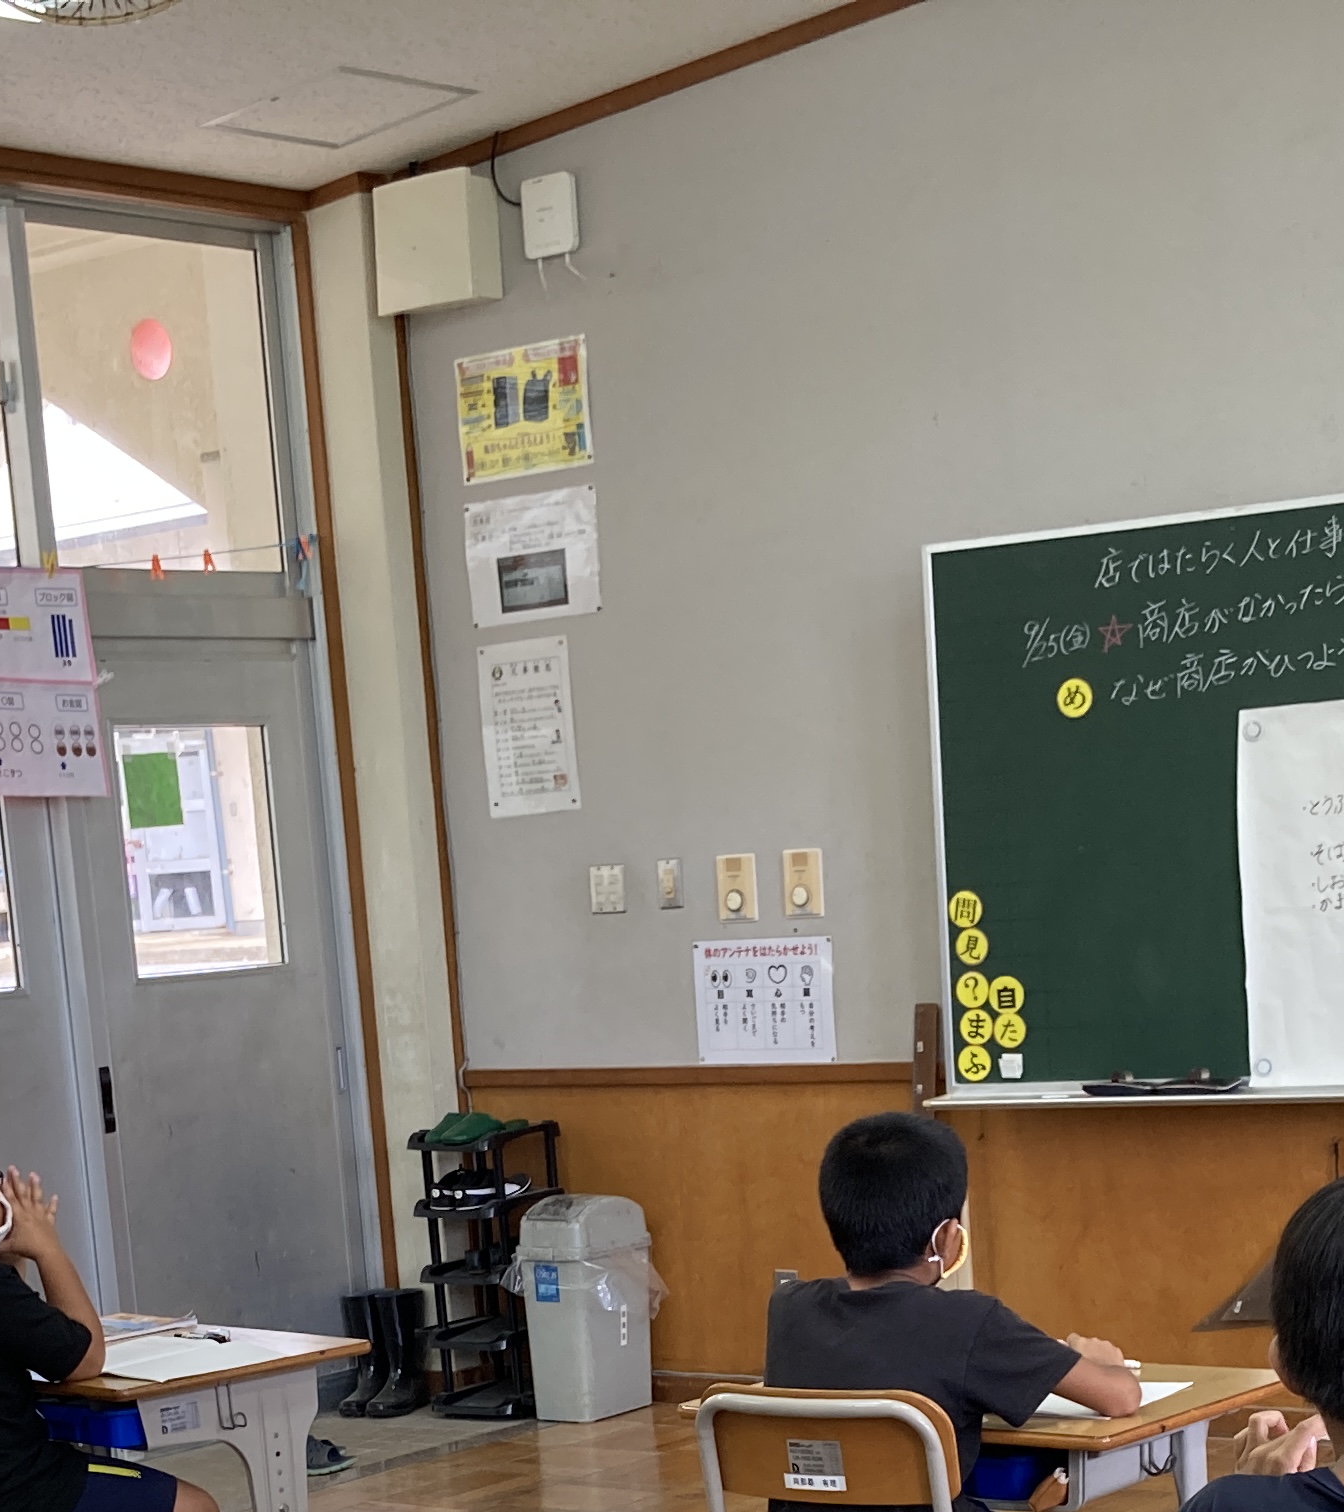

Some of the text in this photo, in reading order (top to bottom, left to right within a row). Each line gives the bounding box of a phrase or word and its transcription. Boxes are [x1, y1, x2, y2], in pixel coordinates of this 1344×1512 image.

[1094, 514, 1344, 589] 店ではたらく人と仕事
[1063, 687, 1087, 709] め
[954, 897, 978, 924] 問
[959, 935, 981, 961] 見
[963, 976, 979, 1002] ?
[996, 985, 1017, 1010] 自
[967, 1013, 987, 1040] ま
[999, 1019, 1019, 1042] た
[964, 1051, 987, 1075] ふ
